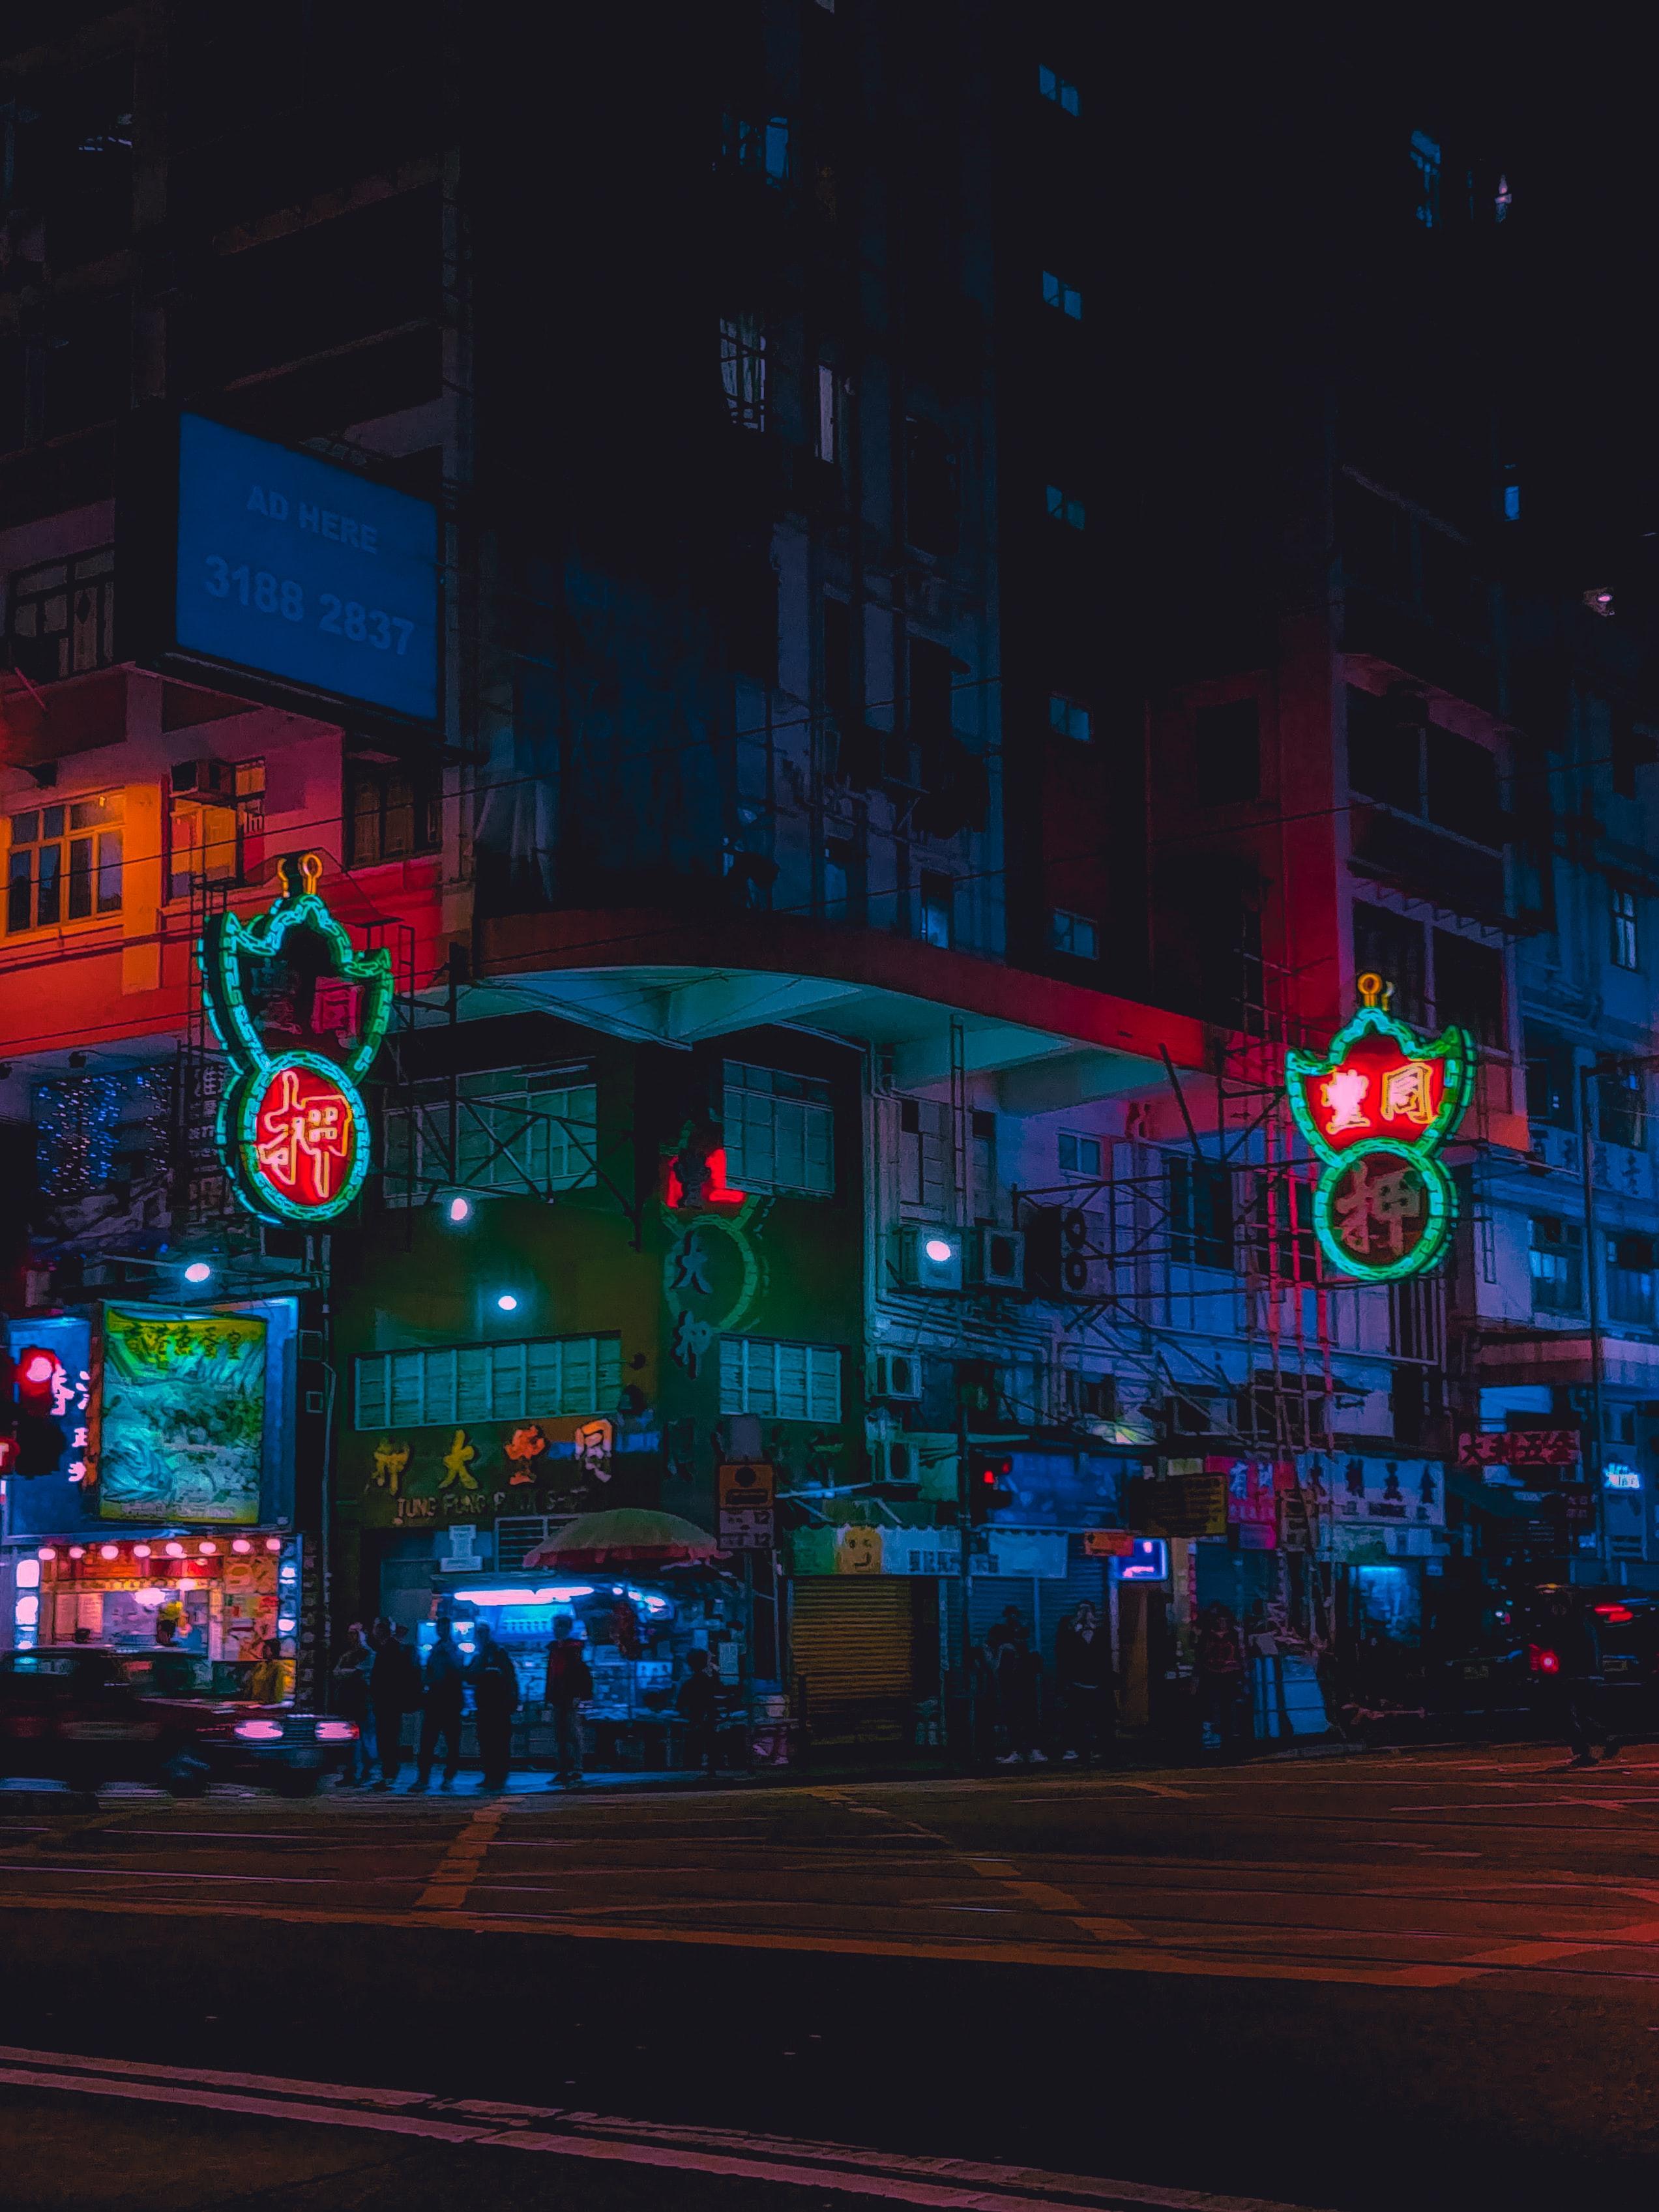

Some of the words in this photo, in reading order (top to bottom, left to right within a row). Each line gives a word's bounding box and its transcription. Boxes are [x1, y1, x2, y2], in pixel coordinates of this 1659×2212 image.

[246, 484, 289, 521] AD
[298, 501, 379, 555] HERE
[204, 553, 305, 623] 3188
[319, 593, 415, 656] 2837
